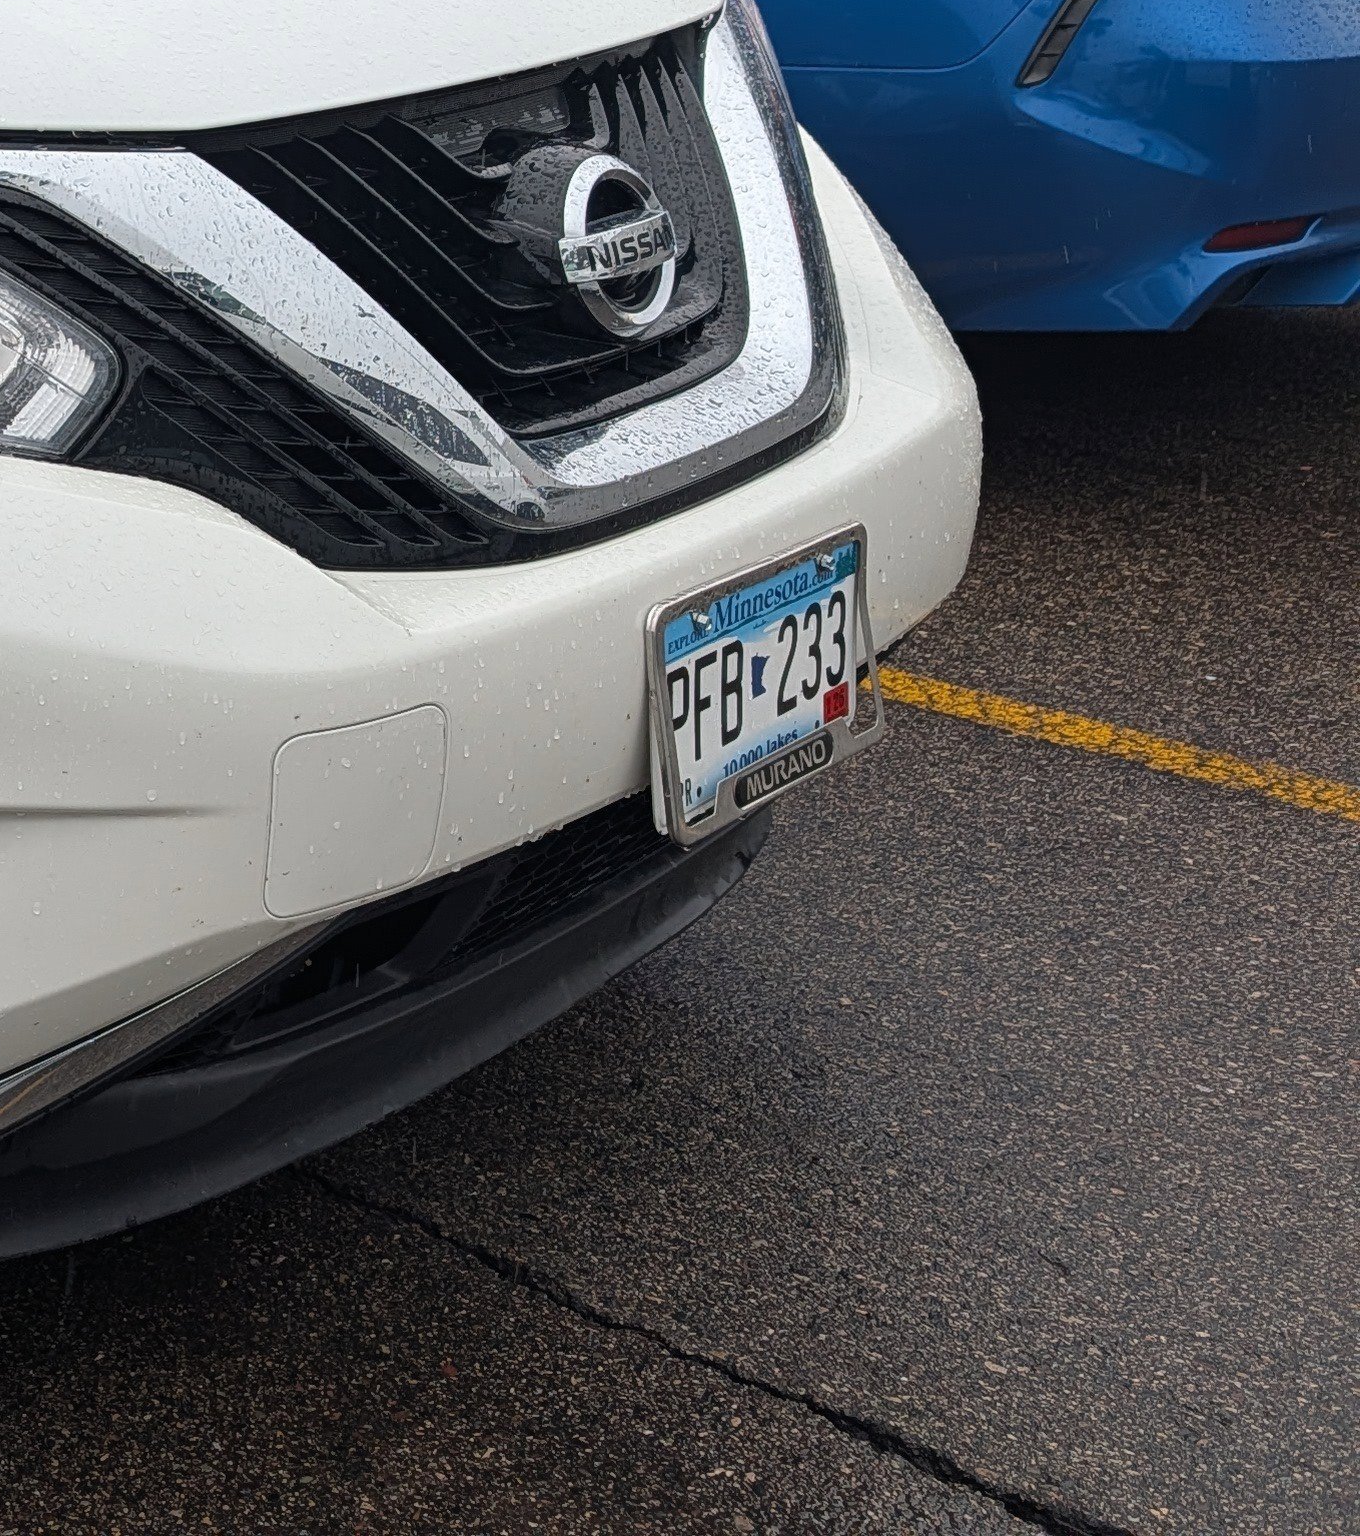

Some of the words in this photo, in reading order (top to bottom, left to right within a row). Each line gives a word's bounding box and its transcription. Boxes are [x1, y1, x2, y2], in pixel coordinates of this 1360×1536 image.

[586, 225, 674, 271] NISSAN
[666, 639, 744, 762] PFB
[777, 590, 846, 717] 233
[766, 728, 798, 755] lakes
[745, 739, 827, 801] MURANO
